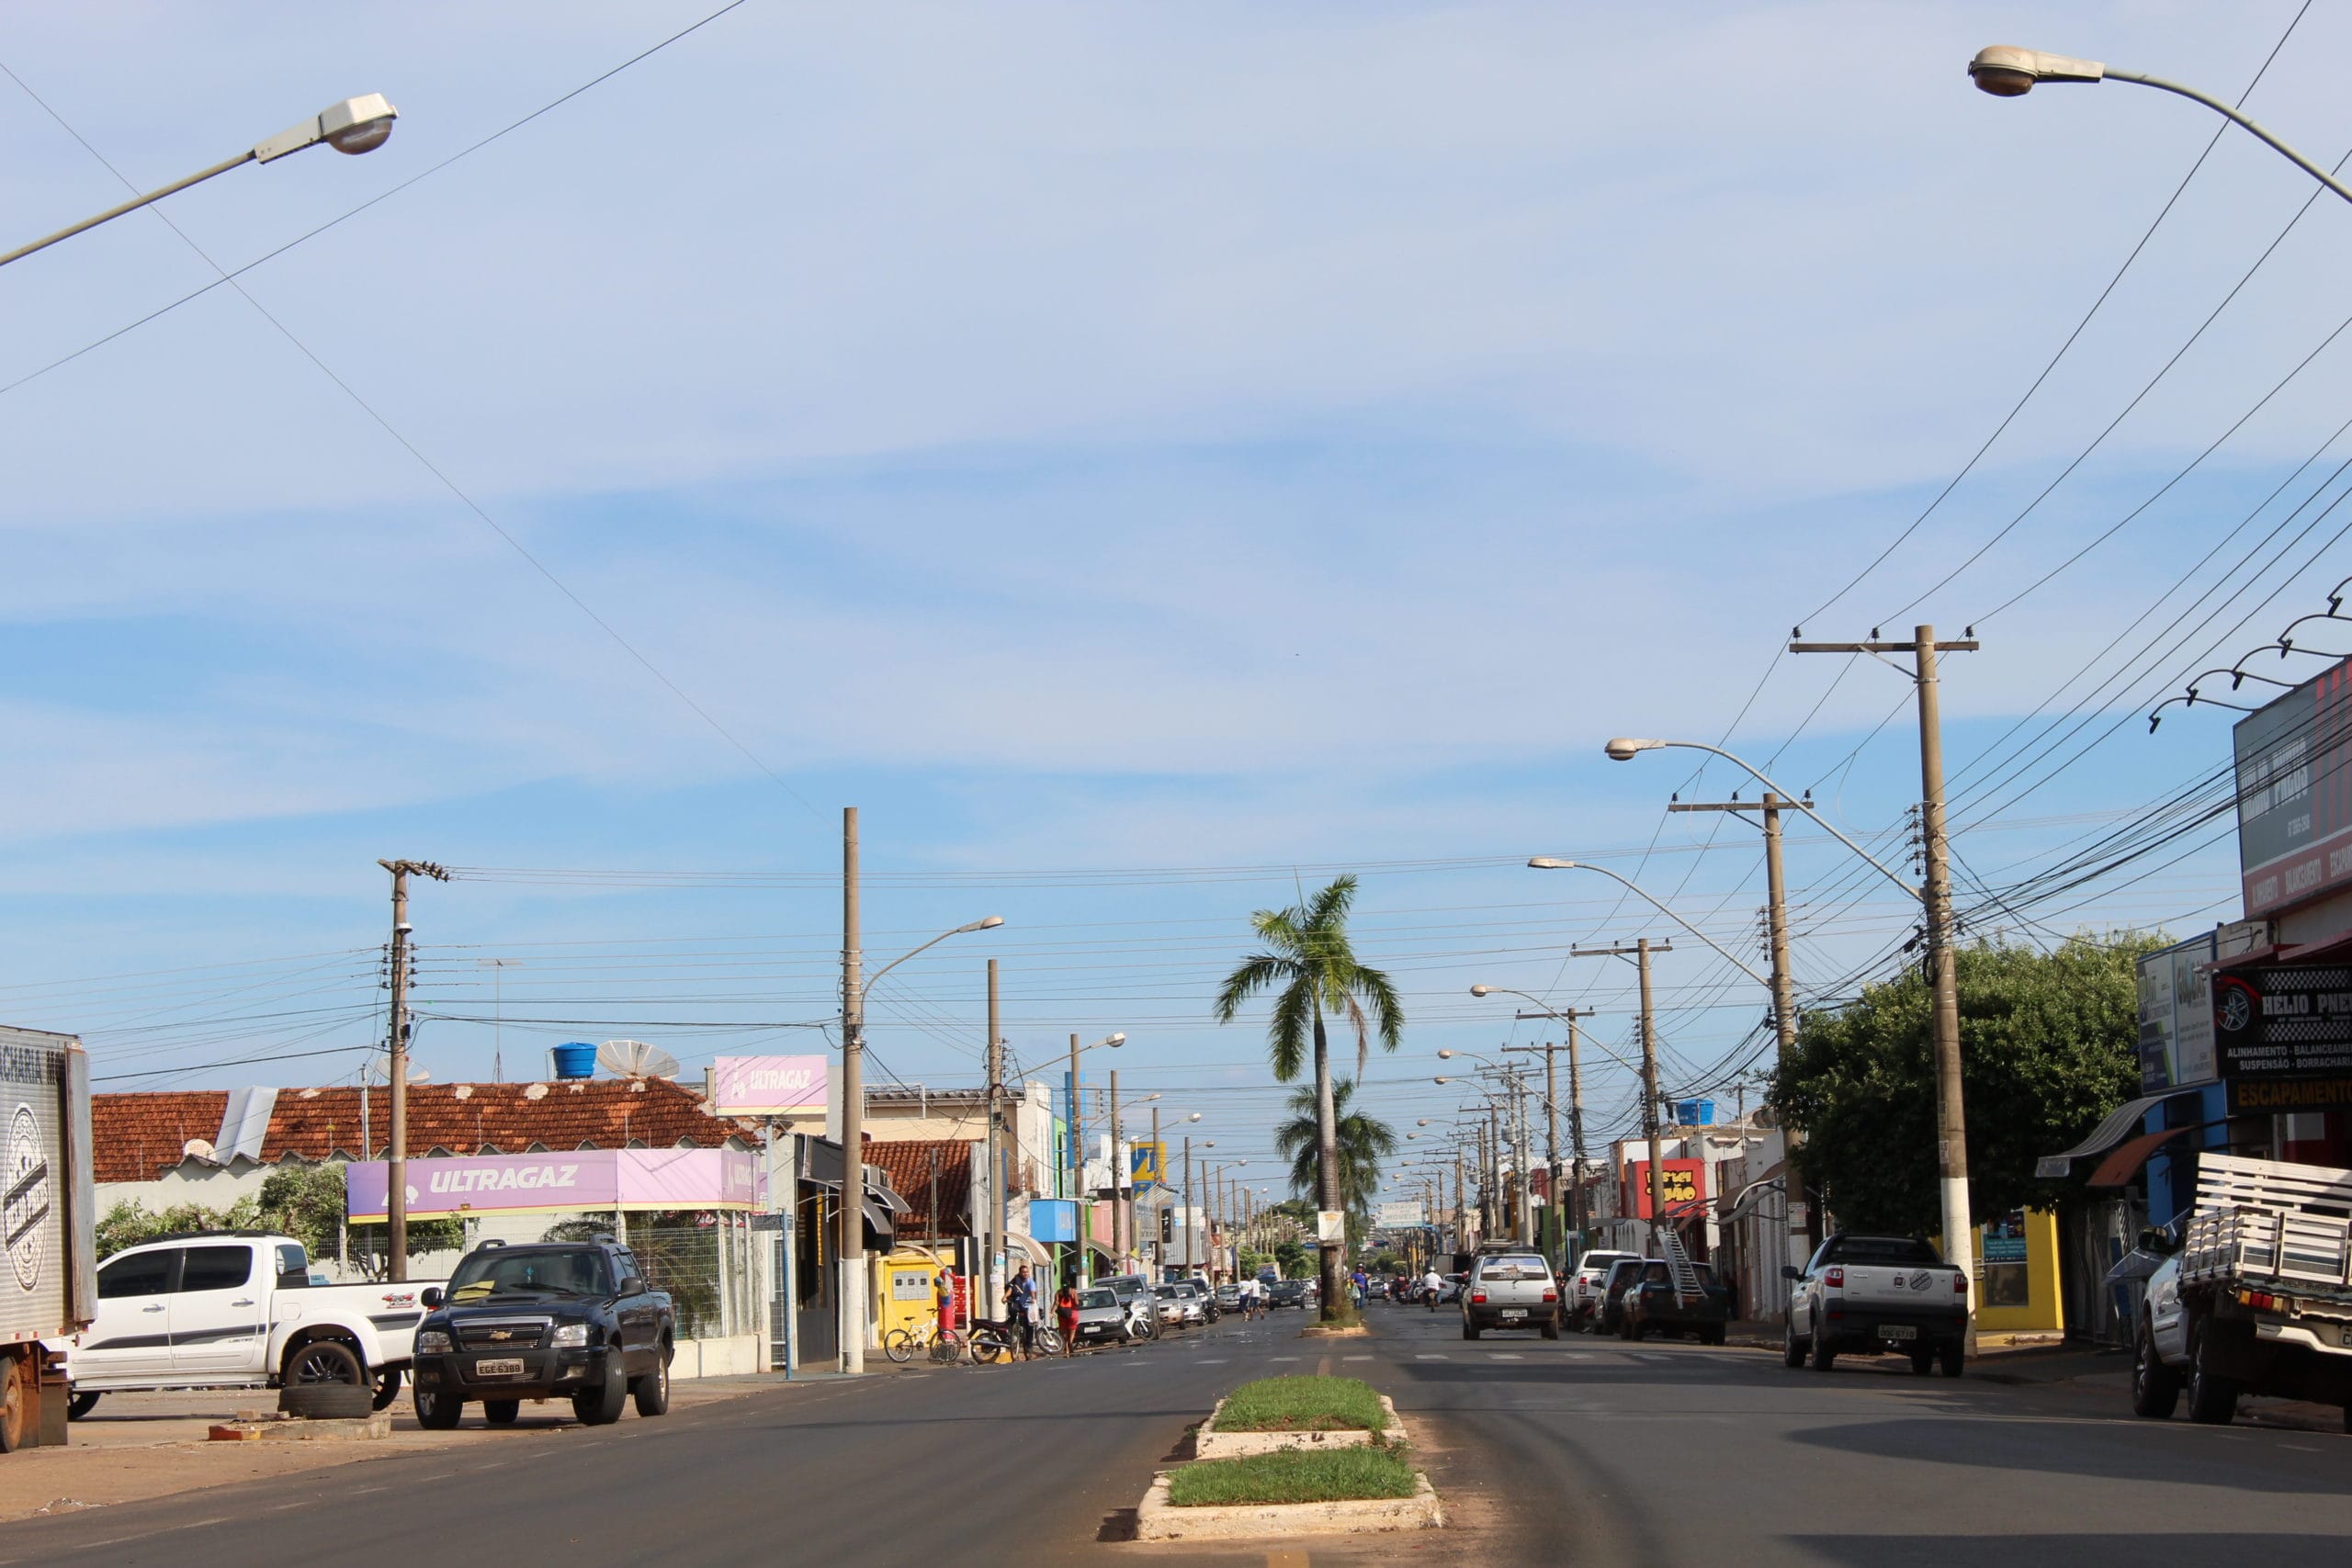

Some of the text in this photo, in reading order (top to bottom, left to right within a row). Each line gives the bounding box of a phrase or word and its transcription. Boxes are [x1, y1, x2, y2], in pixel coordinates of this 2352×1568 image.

[2272, 737, 2308, 809] PNEUS
[2262, 990, 2352, 1015] HÉLIO PNE
[2227, 1046, 2288, 1058] ALINHAMENTO
[2294, 1043, 2352, 1055] BALANCEAME
[2239, 1057, 2290, 1071] SUSPENSÃO
[750, 1069, 811, 1090] ULTRAGAZ
[430, 1165, 579, 1193] ULTRAGAZ
